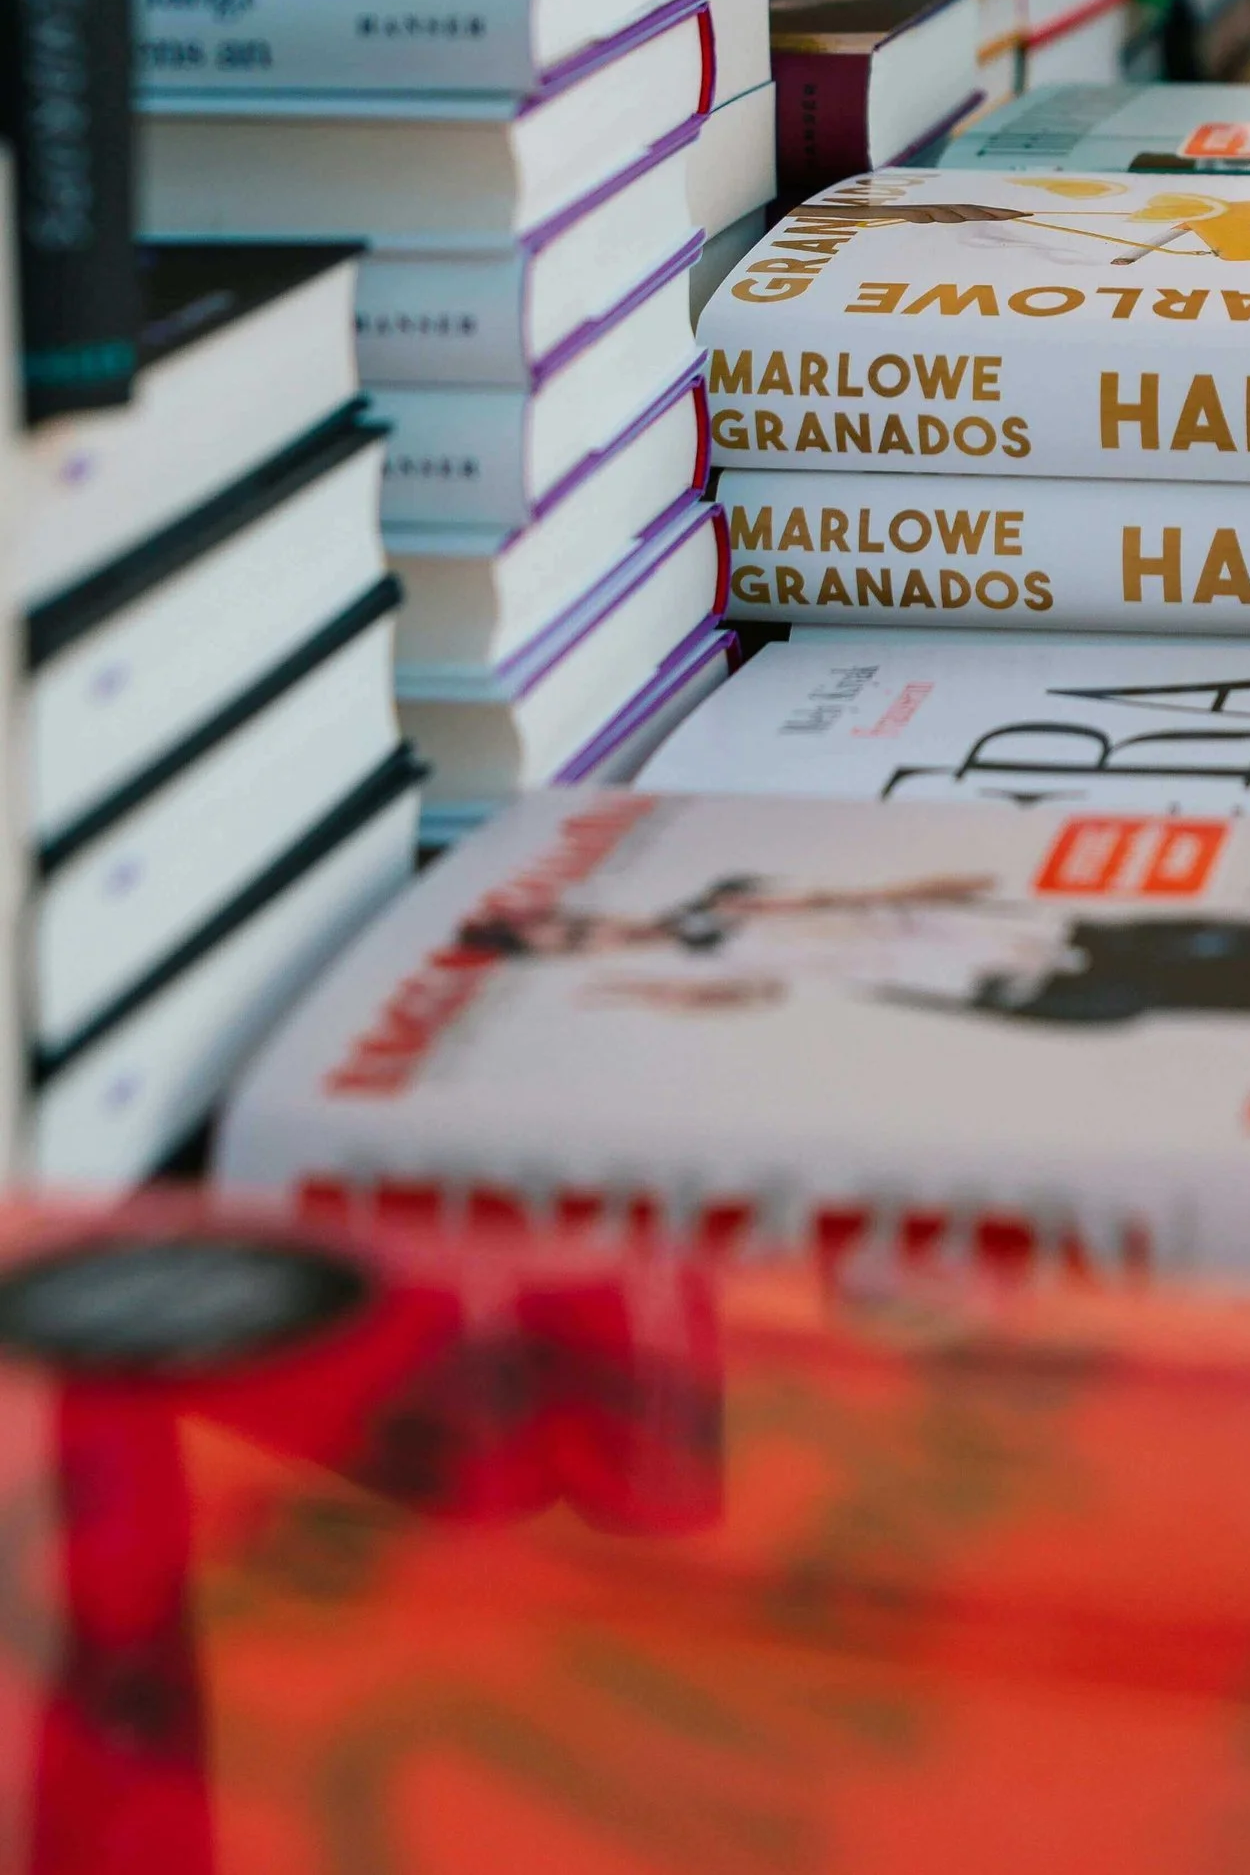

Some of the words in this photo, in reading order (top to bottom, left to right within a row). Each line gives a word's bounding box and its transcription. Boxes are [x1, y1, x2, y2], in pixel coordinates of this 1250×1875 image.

[709, 349, 1002, 402] MARLOWE
[711, 408, 1031, 459] GRANADOS
[730, 504, 1024, 557] MARLOWE
[730, 564, 1054, 613] GRANADOS
